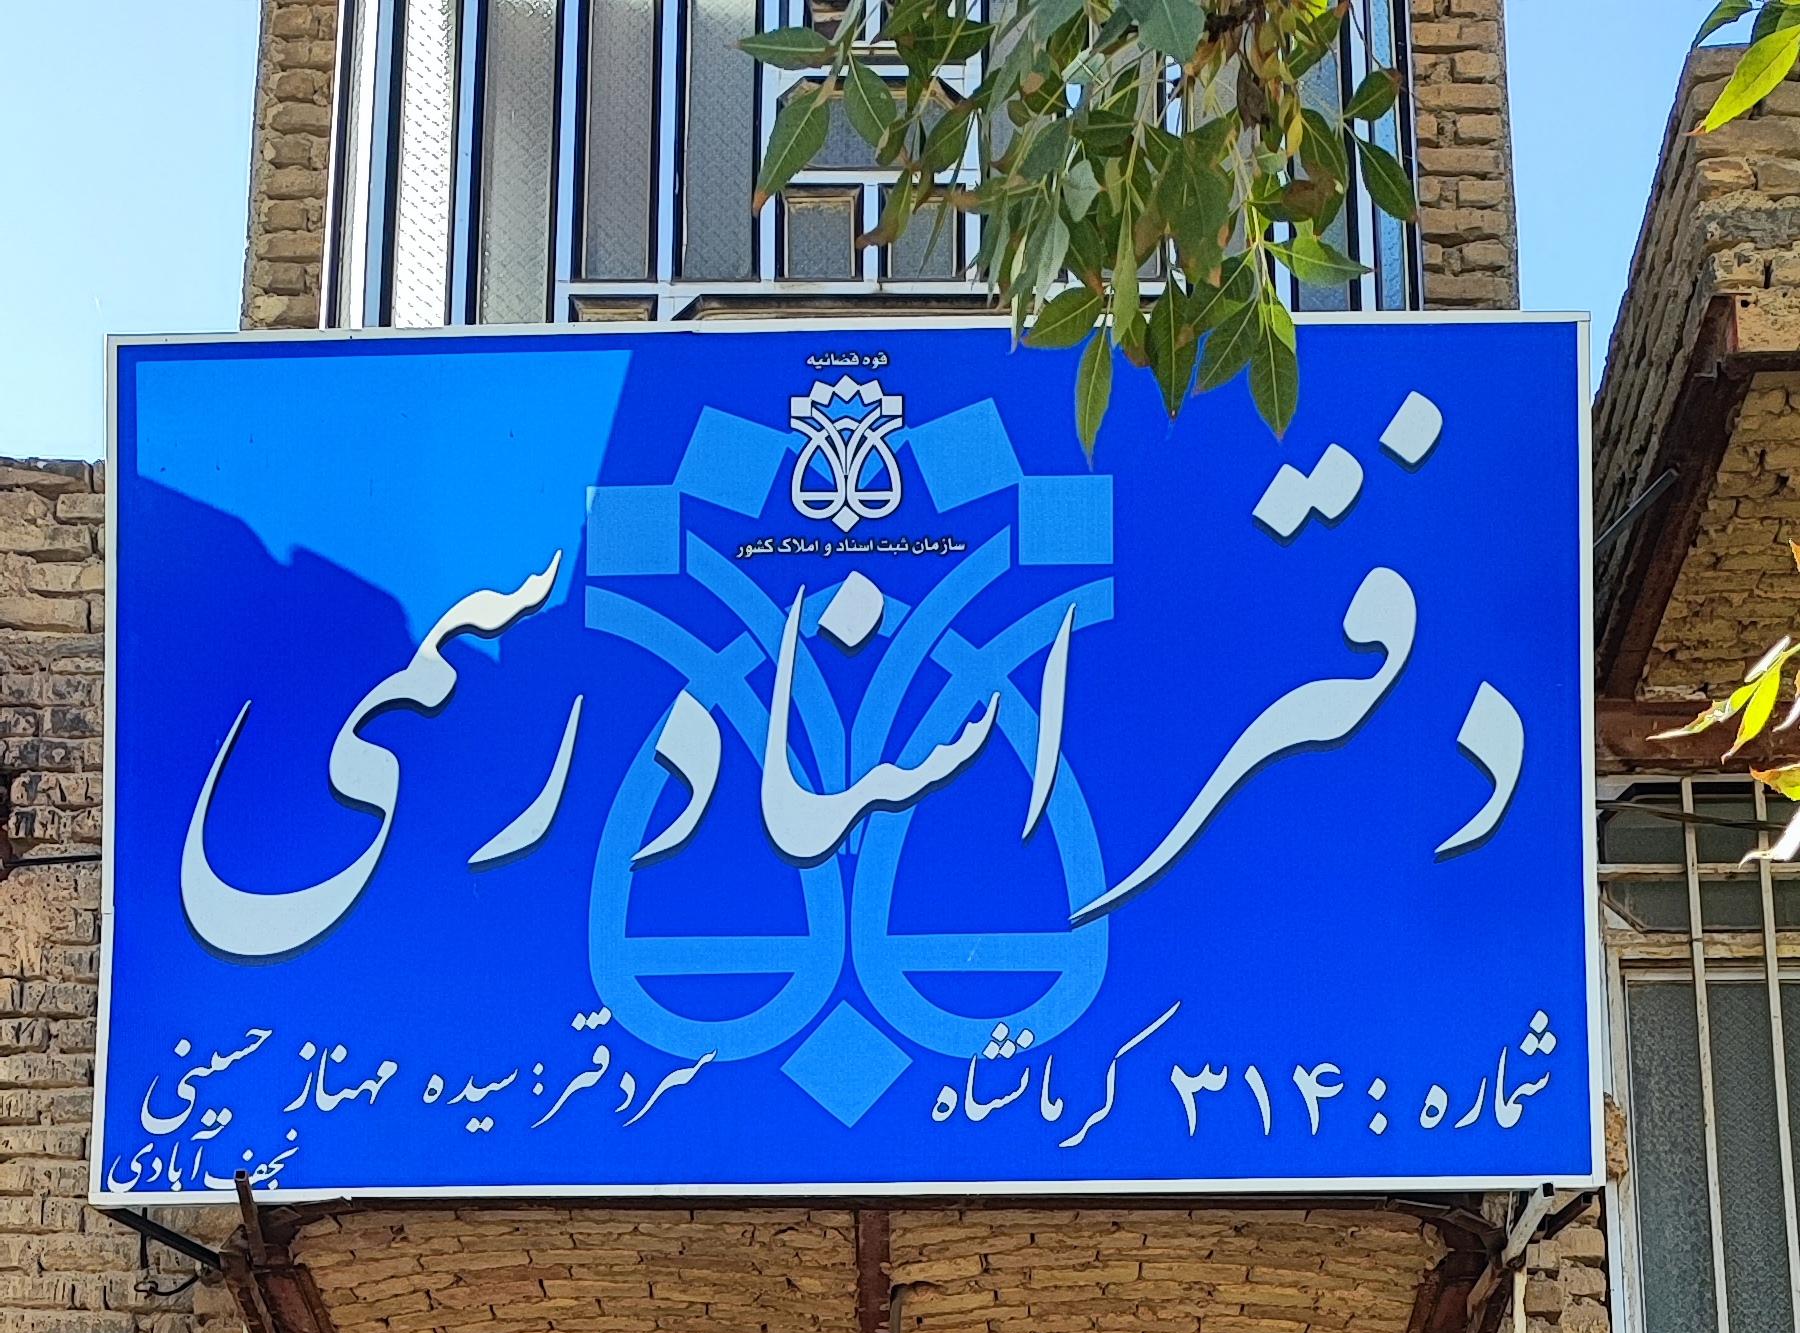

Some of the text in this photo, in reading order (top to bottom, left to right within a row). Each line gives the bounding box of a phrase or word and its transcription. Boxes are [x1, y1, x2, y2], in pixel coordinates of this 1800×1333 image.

[863, 351, 889, 369] قوه
[735, 537, 966, 558] سازمان ثبت اسناد و املاک کشور
[180, 388, 1527, 960] دفتر اسناد رسمی
[139, 1027, 274, 1137] حسینی
[283, 1040, 399, 1114] مهناز
[422, 1071, 519, 1134] سیده
[931, 1000, 1181, 1149] کرمانشاه
[1170, 1062, 1345, 1136] ۳۱۴
